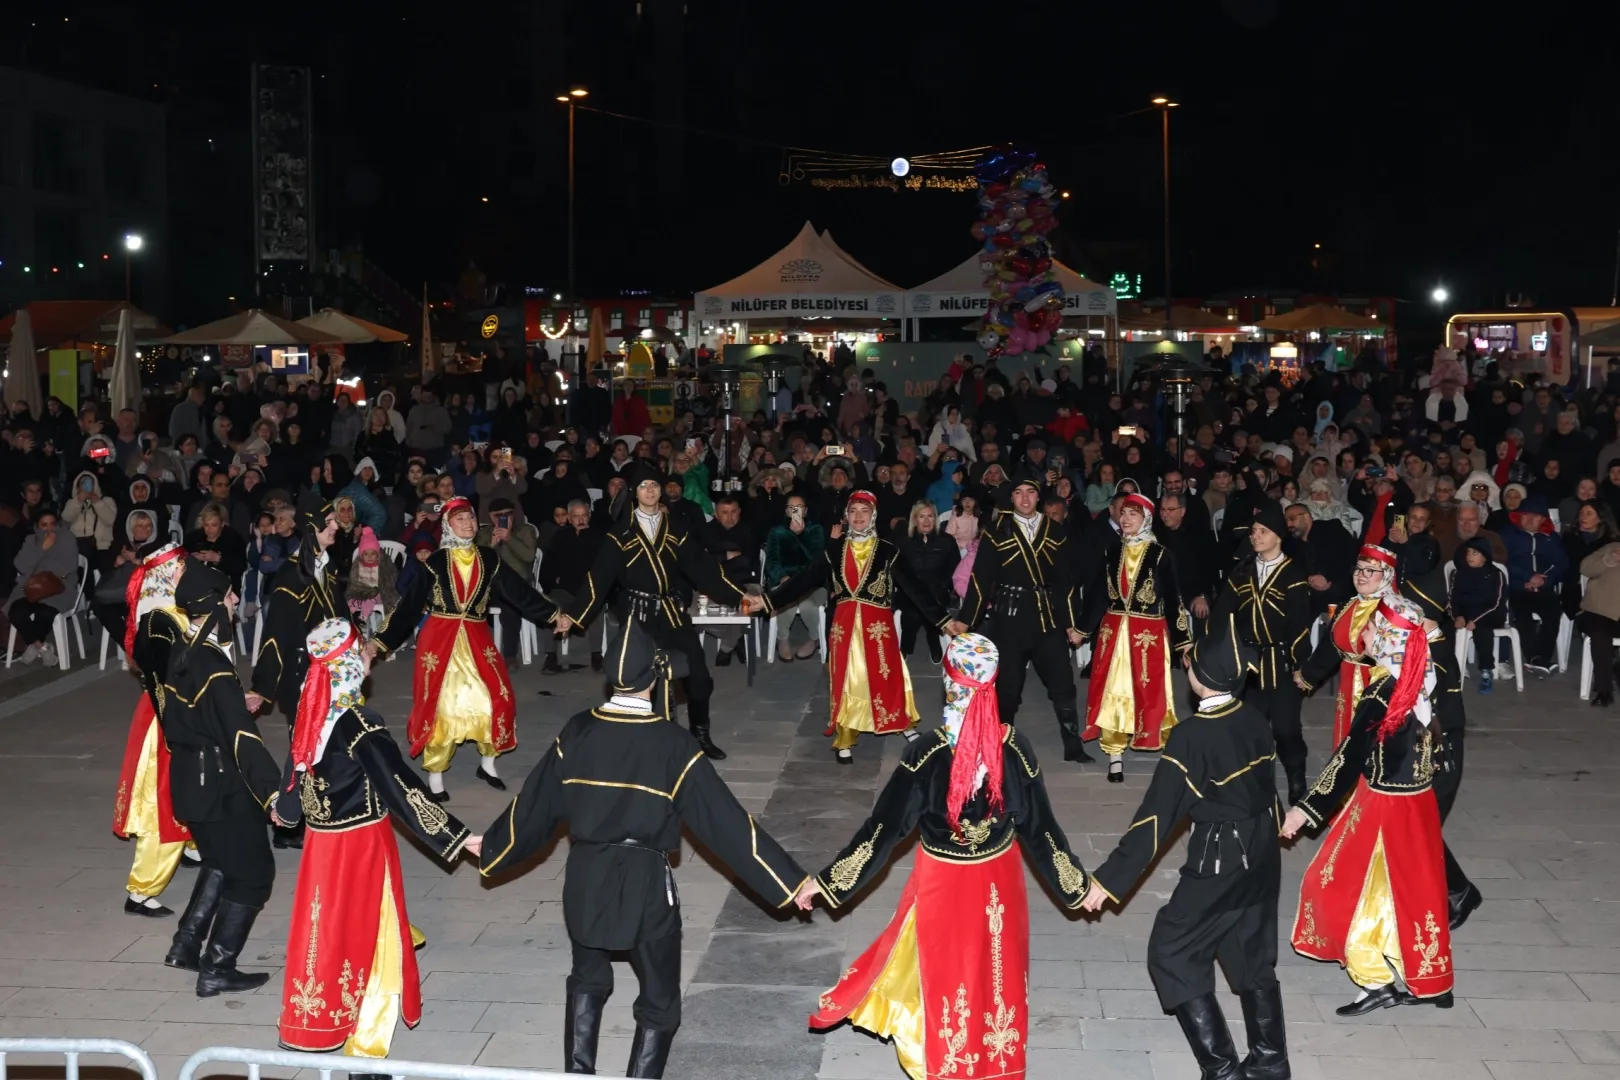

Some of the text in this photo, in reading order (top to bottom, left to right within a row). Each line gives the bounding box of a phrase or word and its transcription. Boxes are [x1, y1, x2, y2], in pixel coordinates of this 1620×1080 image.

[731, 298, 788, 312] NİLÜFER
[791, 297, 869, 311] BELEDİYESİ
[939, 297, 990, 311] NİLÜFE
